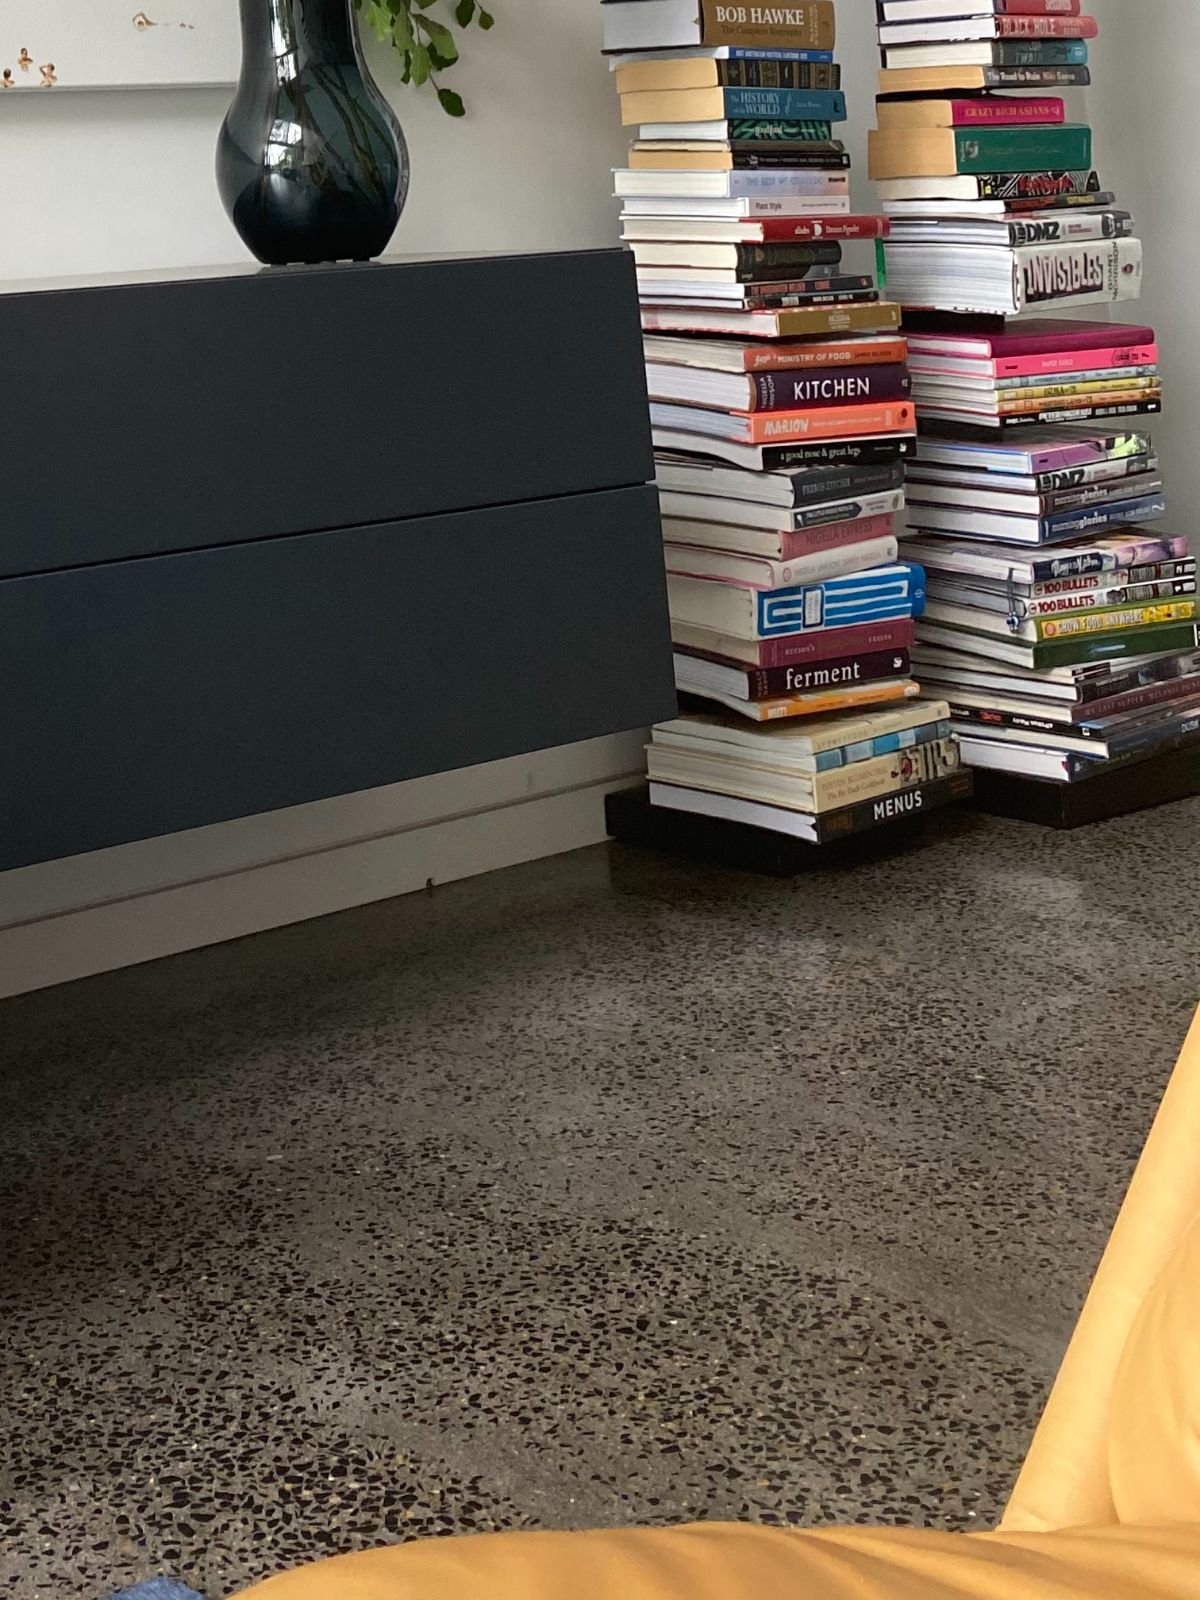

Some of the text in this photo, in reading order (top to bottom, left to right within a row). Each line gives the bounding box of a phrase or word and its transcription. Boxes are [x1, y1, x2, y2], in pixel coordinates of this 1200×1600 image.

[715, 6, 747, 22] BOB
[750, 8, 805, 25] HAWKE
[1002, 18, 1031, 35] BLACK
[1033, 18, 1056, 35] HOLE
[987, 72, 1000, 81] The
[741, 92, 781, 103] HISTORY
[745, 103, 780, 115] WORLD
[965, 107, 993, 117] CRAZY
[1019, 106, 1049, 116] ASIANS
[1026, 221, 1060, 242] DMZ
[1025, 252, 1103, 295] INVISIBLES
[778, 353, 814, 363] MINISTRY
[815, 352, 826, 361] OF
[828, 351, 851, 360] FOOD
[793, 376, 870, 401] KITCHEN
[764, 418, 810, 436] MARION
[785, 449, 804, 462] good
[828, 447, 847, 460] great
[1043, 576, 1099, 594] 100 BULLETS
[1038, 595, 1095, 613] 100 BULLETS
[786, 661, 861, 690] ferment
[873, 790, 923, 821] MENUS
